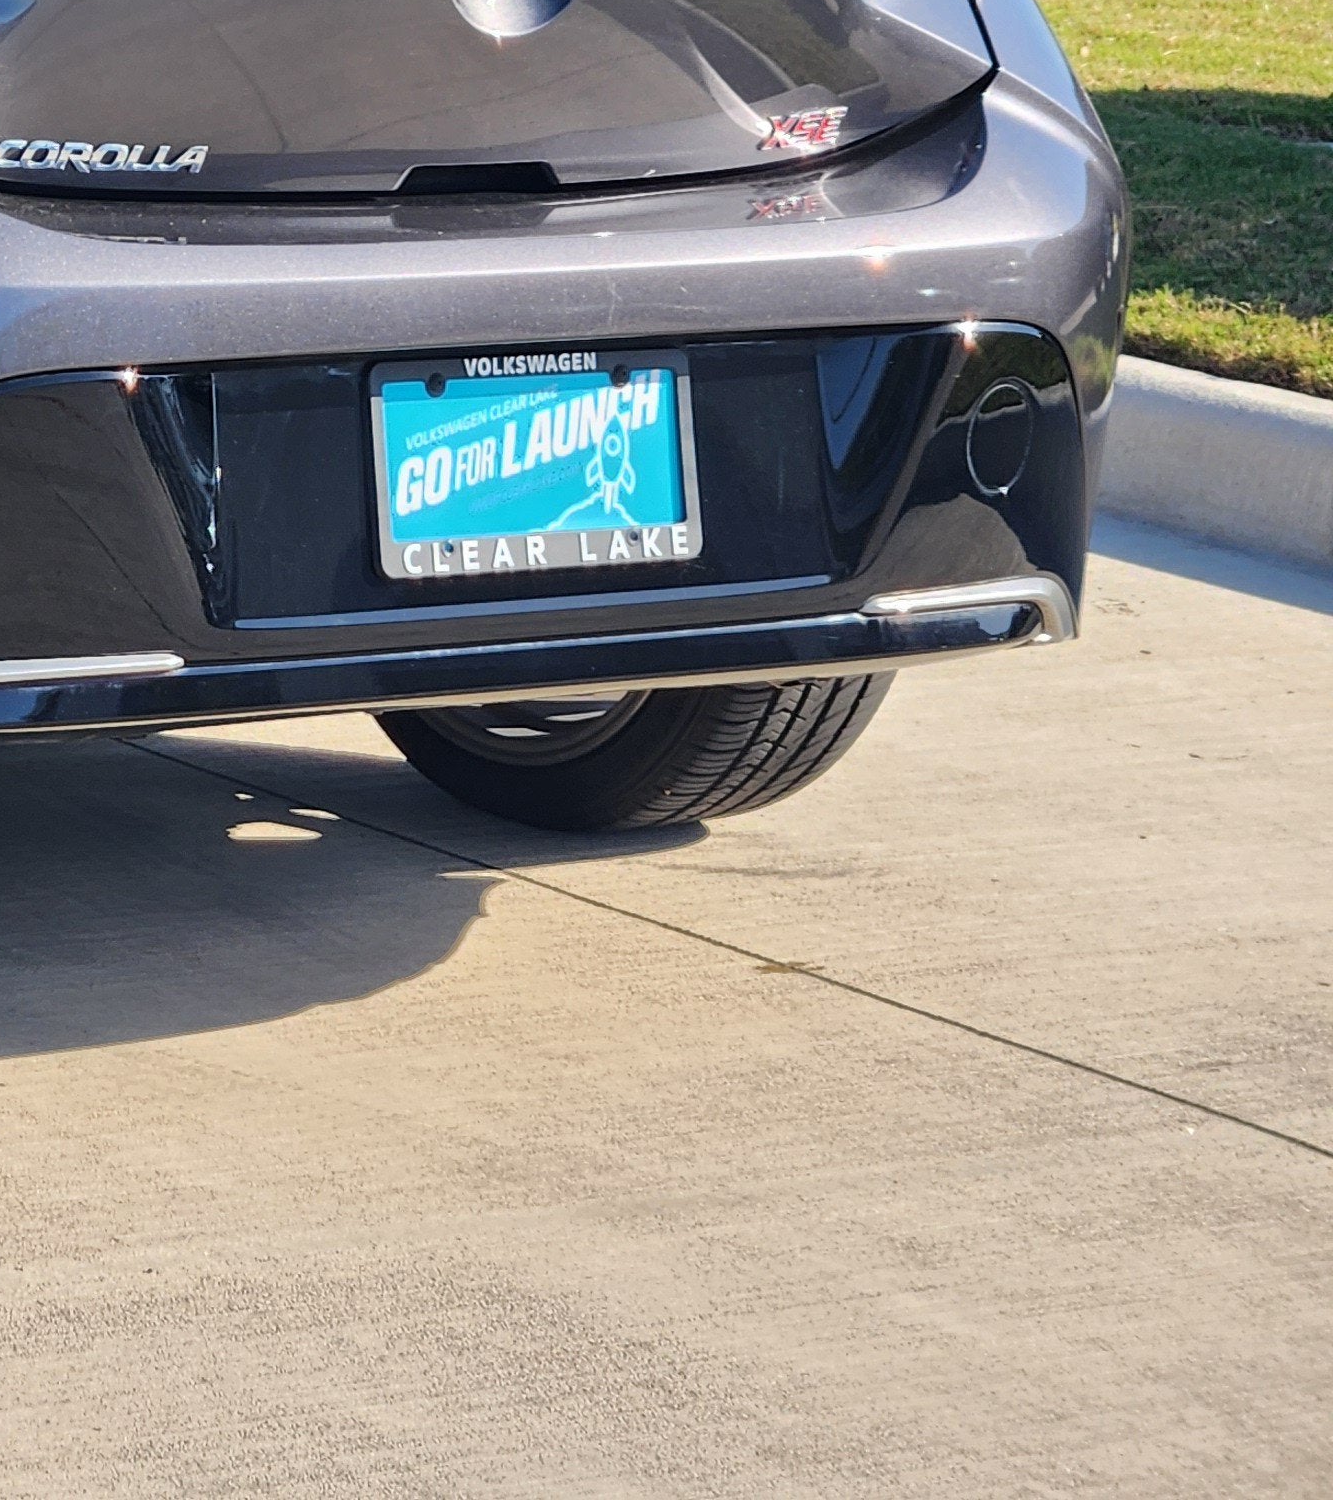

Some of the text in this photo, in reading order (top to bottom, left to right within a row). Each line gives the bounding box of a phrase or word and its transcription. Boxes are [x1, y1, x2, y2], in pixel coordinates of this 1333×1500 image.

[759, 106, 848, 150] XSE
[463, 352, 597, 378] VOLKSWAGEN
[405, 384, 559, 450] VOLKSWAGEN CLEAR LAKE
[396, 445, 452, 516] GO
[454, 435, 497, 491] FOR
[500, 369, 661, 479] LAUNCH
[403, 525, 689, 574] CLEAR LAKE
